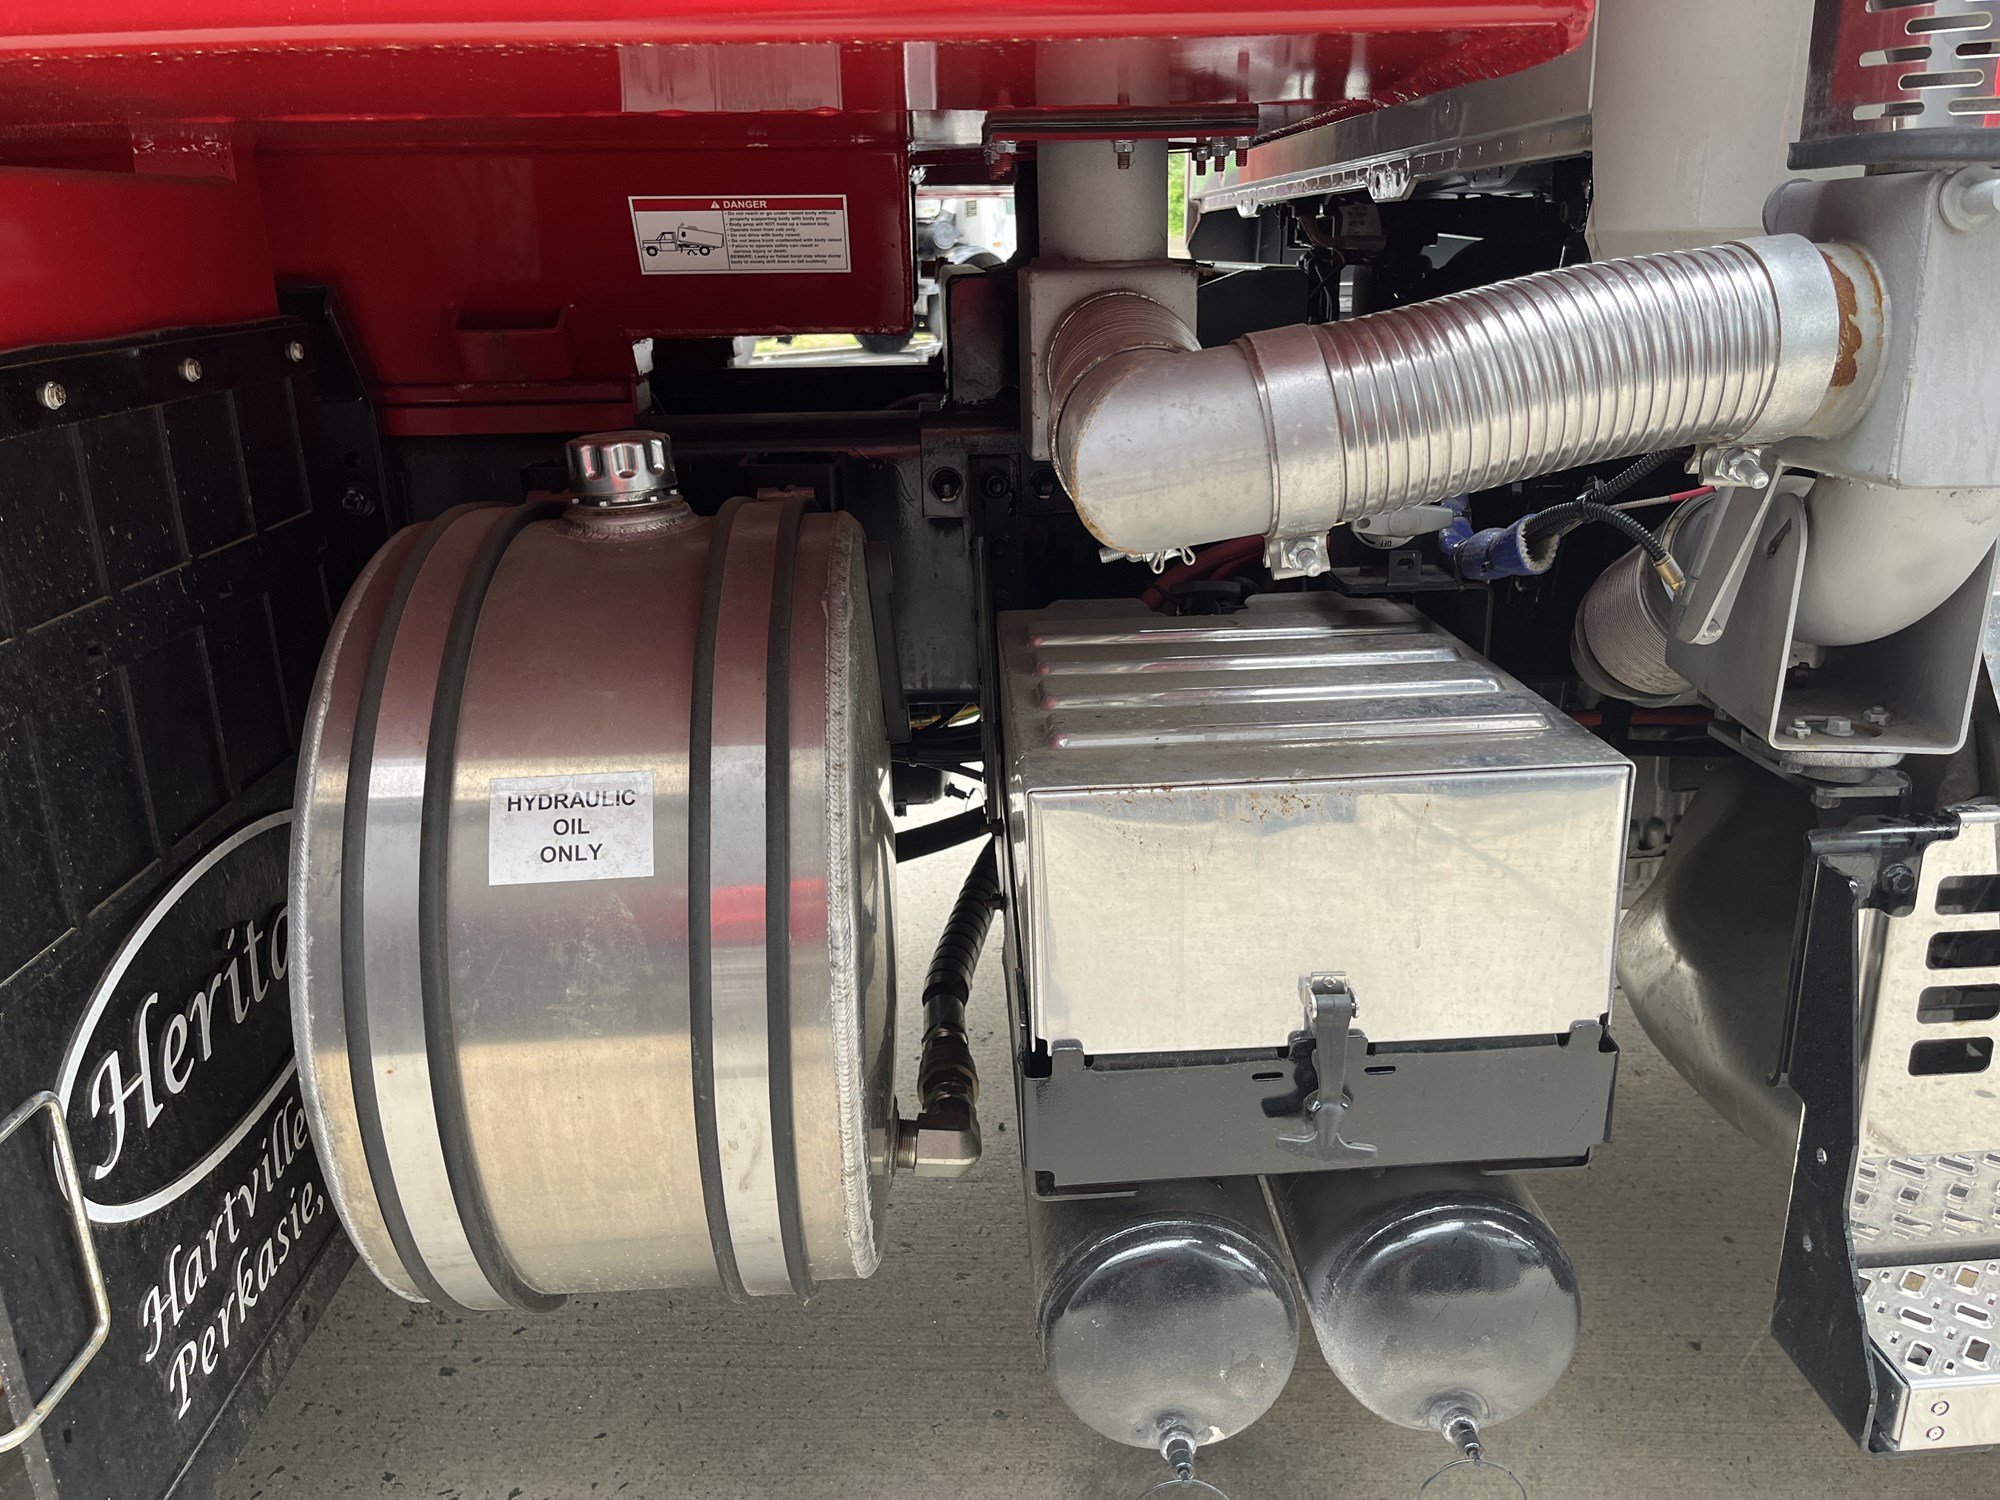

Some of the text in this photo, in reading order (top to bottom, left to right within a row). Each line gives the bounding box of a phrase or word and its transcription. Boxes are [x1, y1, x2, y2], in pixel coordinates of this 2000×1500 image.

[723, 200, 767, 208] DANGER
[507, 789, 636, 812] HYDRAULIC
[553, 818, 590, 836] OIL
[540, 843, 603, 863] ONLY
[143, 1096, 308, 1363] Hartville
[169, 1182, 324, 1420] Perkasie,
